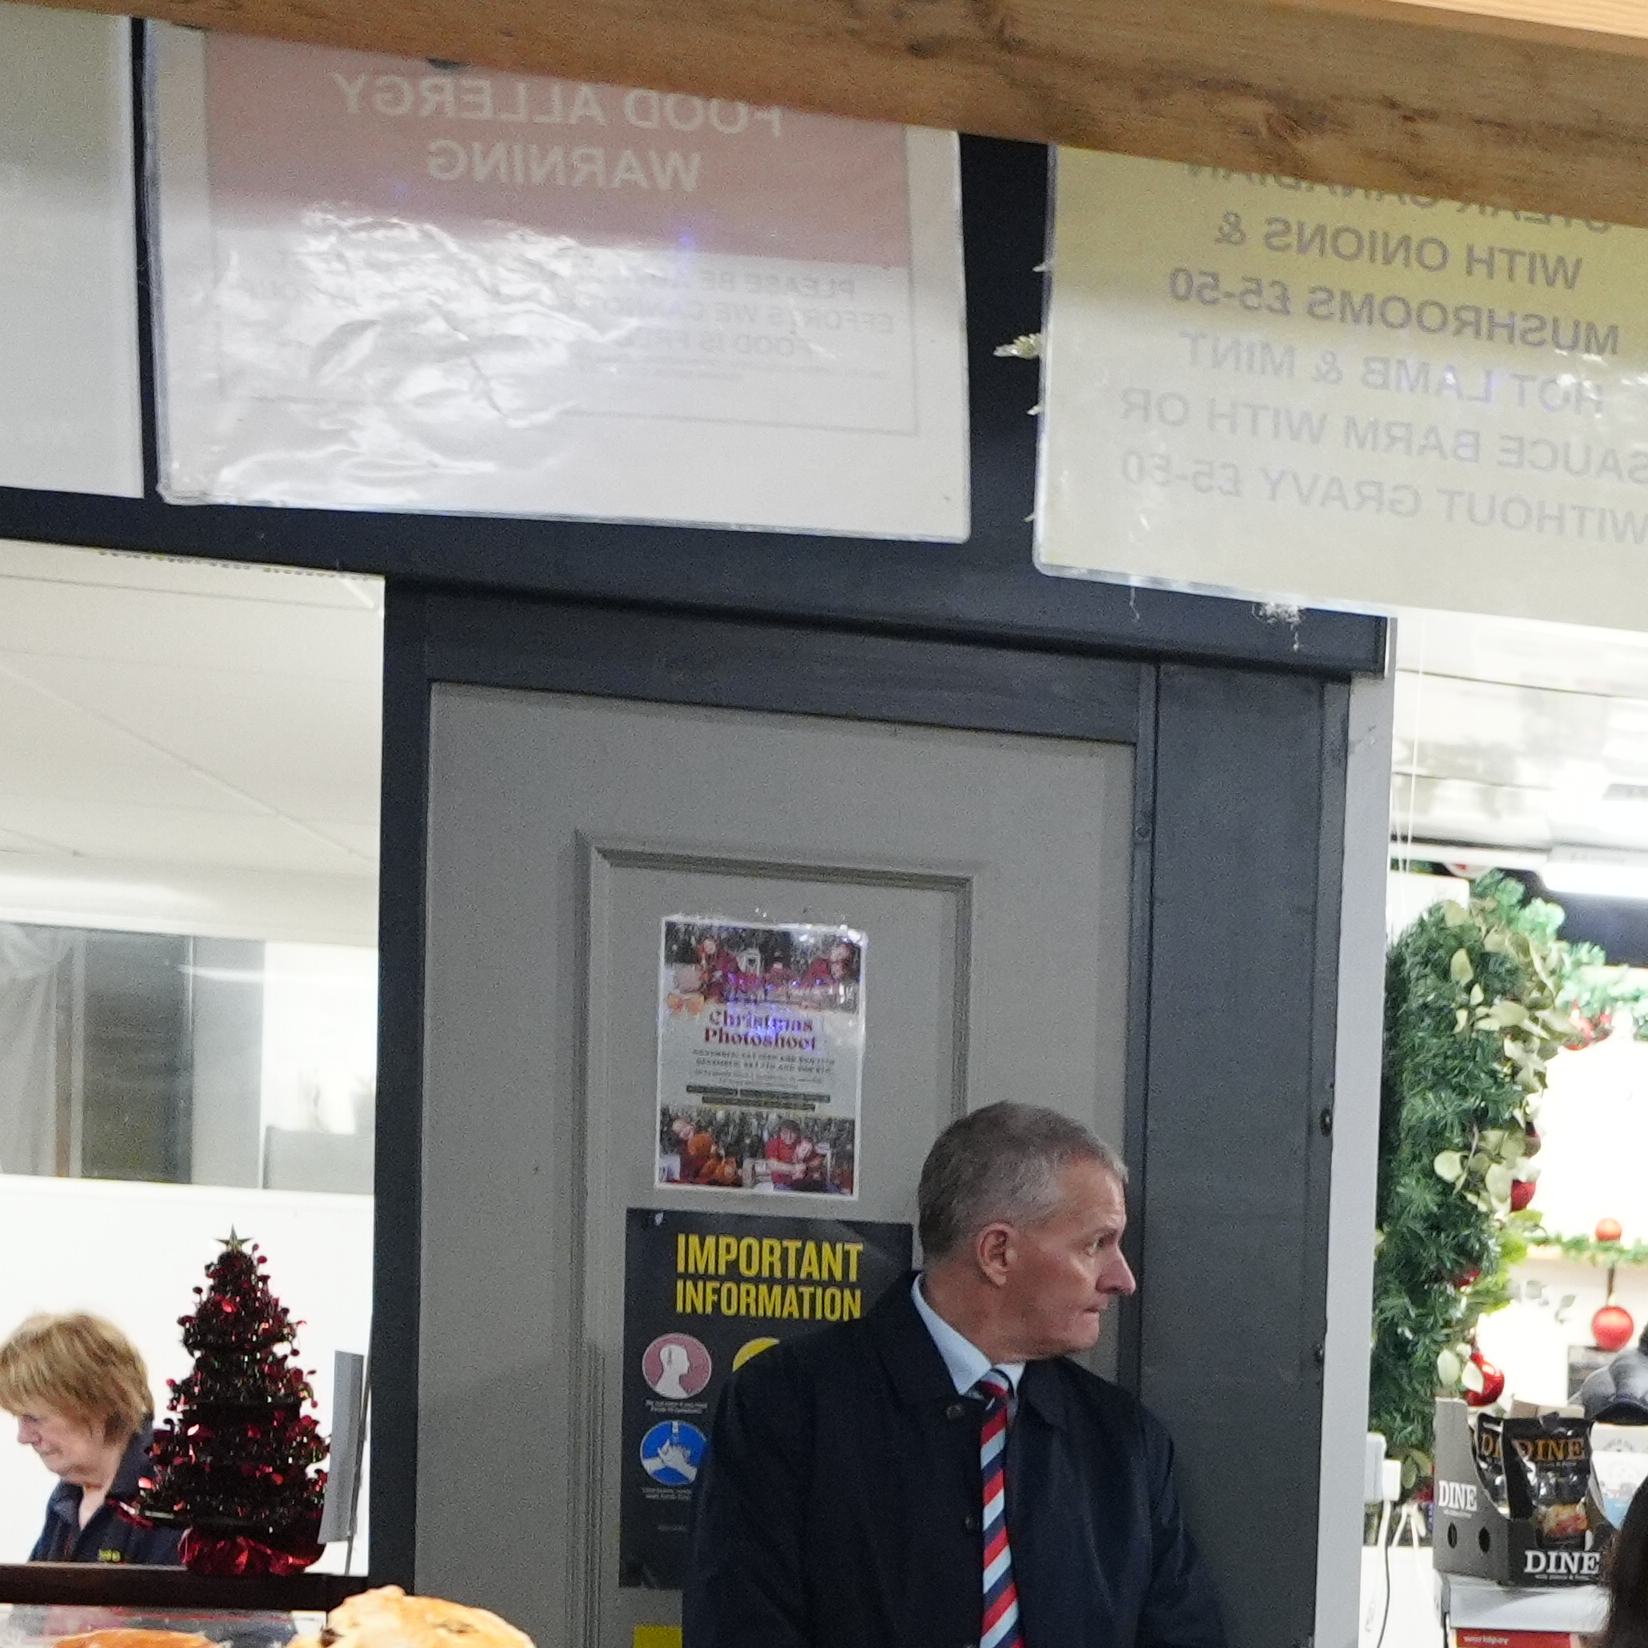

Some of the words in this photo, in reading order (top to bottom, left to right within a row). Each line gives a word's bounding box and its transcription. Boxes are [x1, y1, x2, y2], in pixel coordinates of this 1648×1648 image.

[708, 1009, 814, 1035] Christmas
[704, 1027, 817, 1053] Photoshoot
[676, 1232, 864, 1283] IMPORTANT
[675, 1279, 863, 1321] INFORMATION
[1511, 1436, 1585, 1461] DINE
[1438, 1478, 1478, 1512] DINE
[1525, 1549, 1602, 1575] DINE
